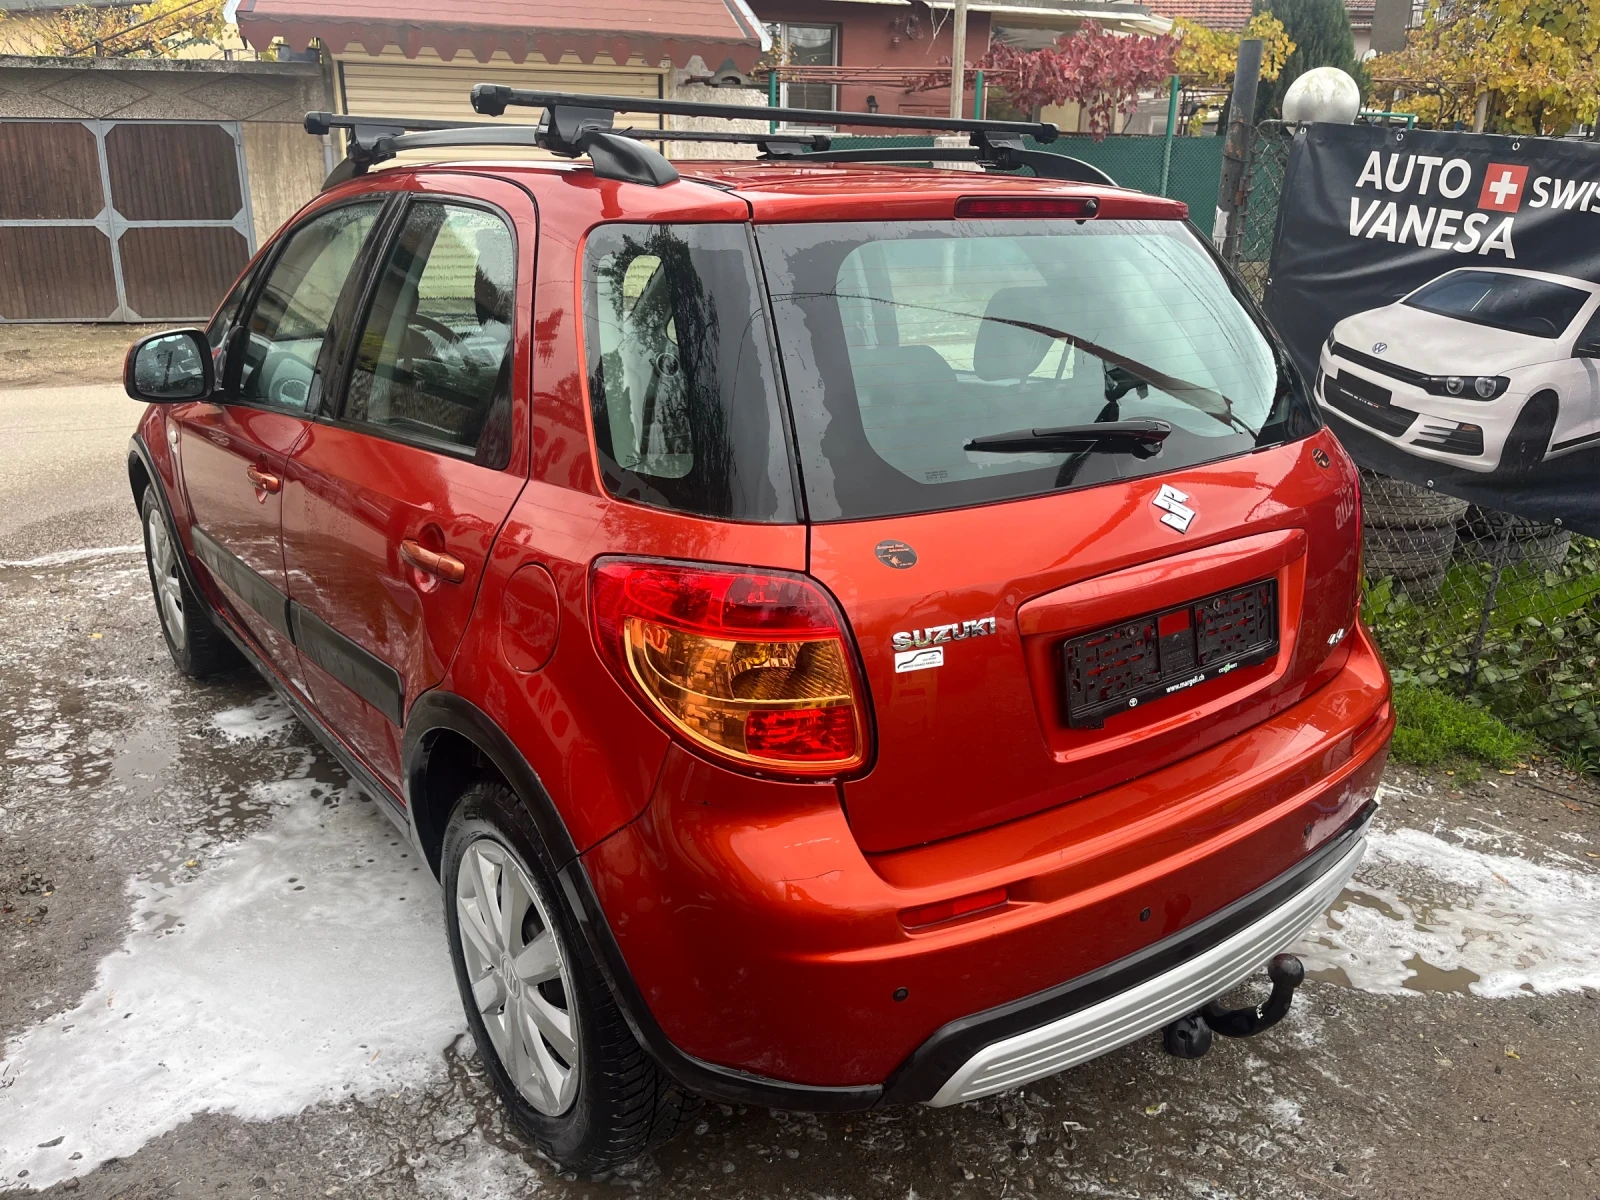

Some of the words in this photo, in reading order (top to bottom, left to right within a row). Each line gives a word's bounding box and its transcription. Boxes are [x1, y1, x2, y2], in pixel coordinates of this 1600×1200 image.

[1355, 151, 1472, 199] AUTO
[1349, 197, 1516, 259] VANESA
[892, 616, 996, 652] SUZUKI
